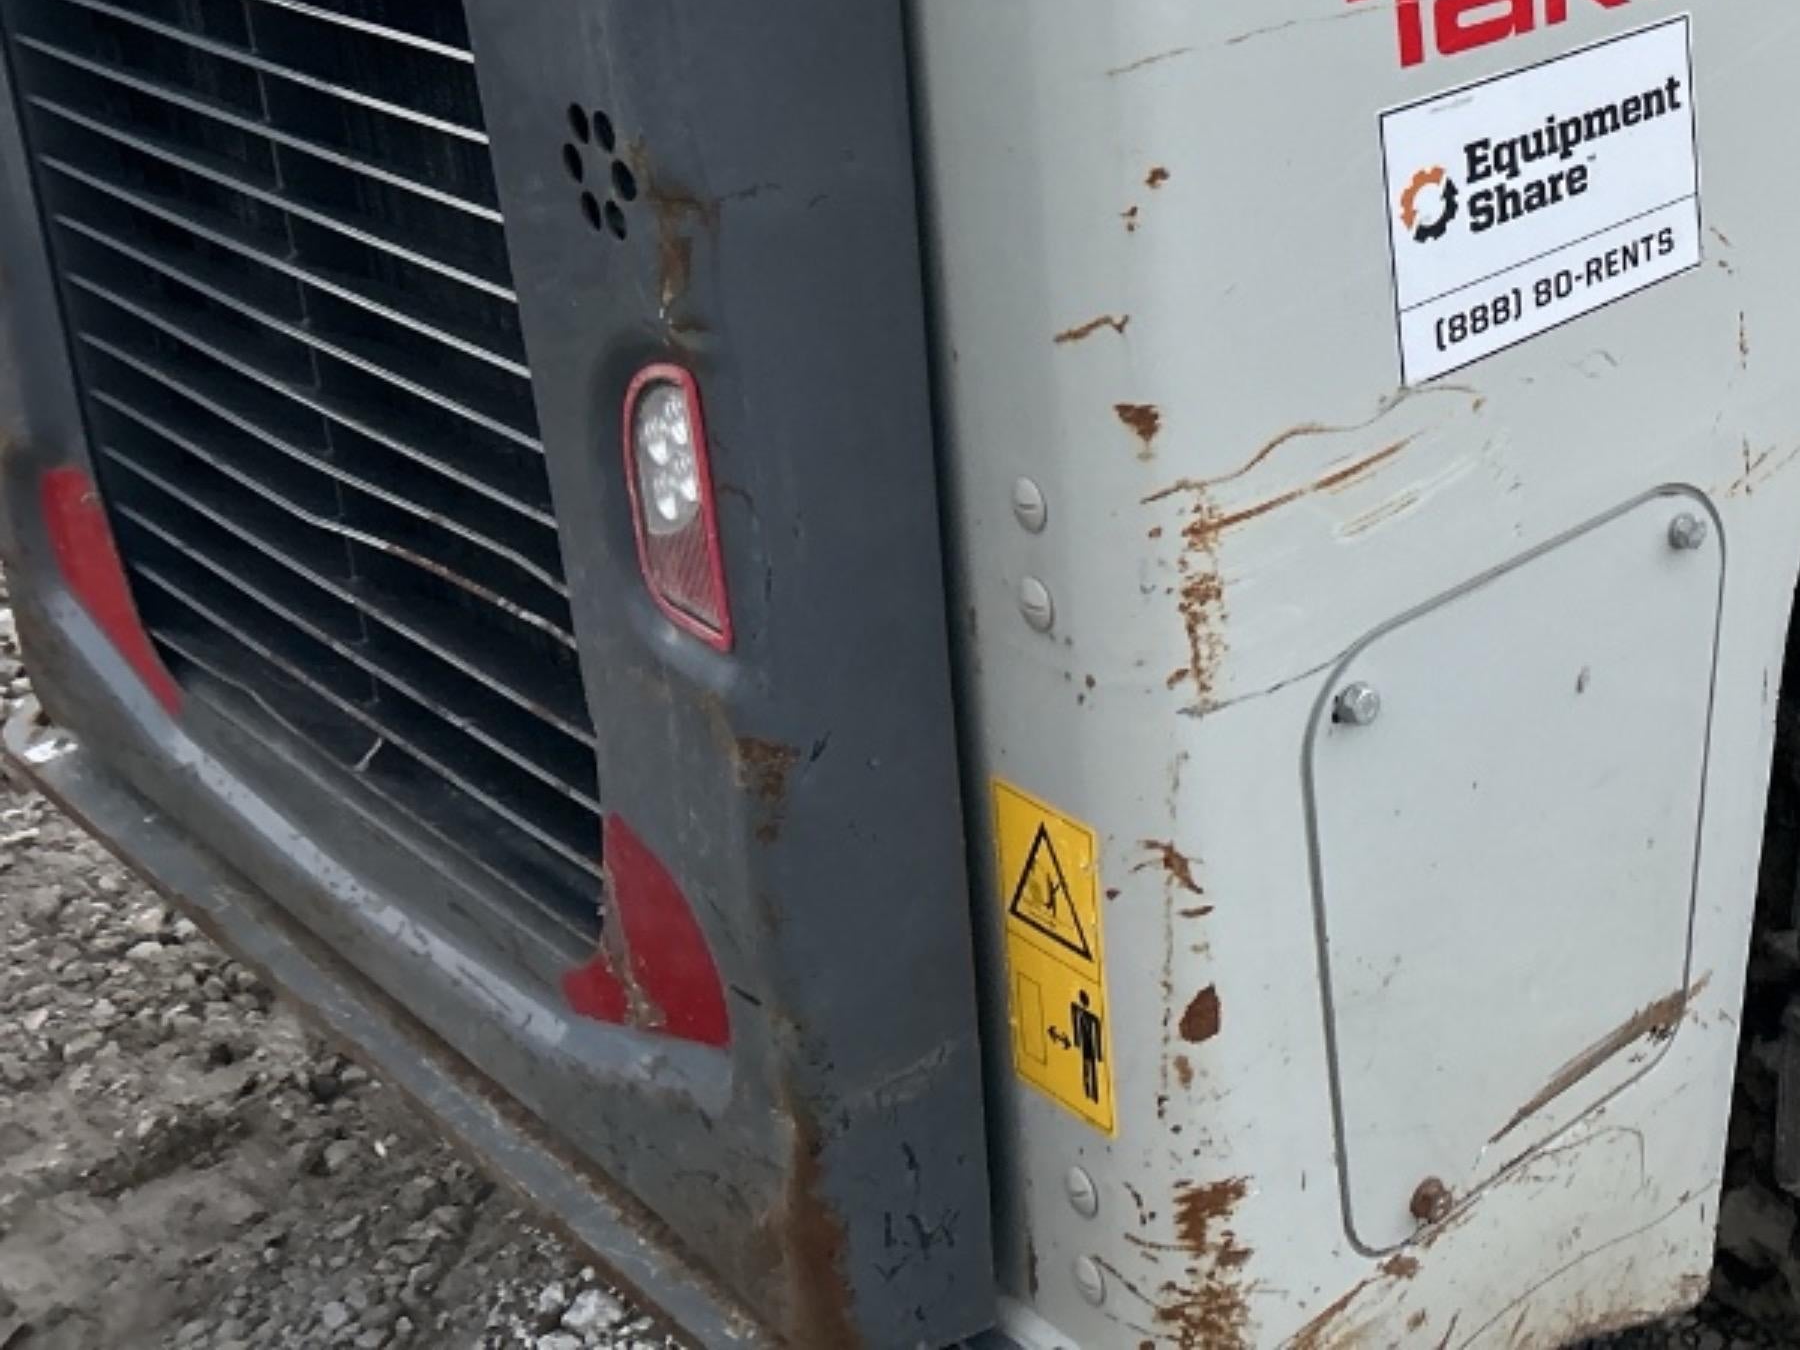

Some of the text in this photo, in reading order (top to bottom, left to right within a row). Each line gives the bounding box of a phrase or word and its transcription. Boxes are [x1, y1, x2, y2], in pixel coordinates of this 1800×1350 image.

[1464, 75, 1681, 184] Equipment
[1466, 163, 1589, 234] Share
[1435, 227, 1675, 352] (888) 80-RENTS
